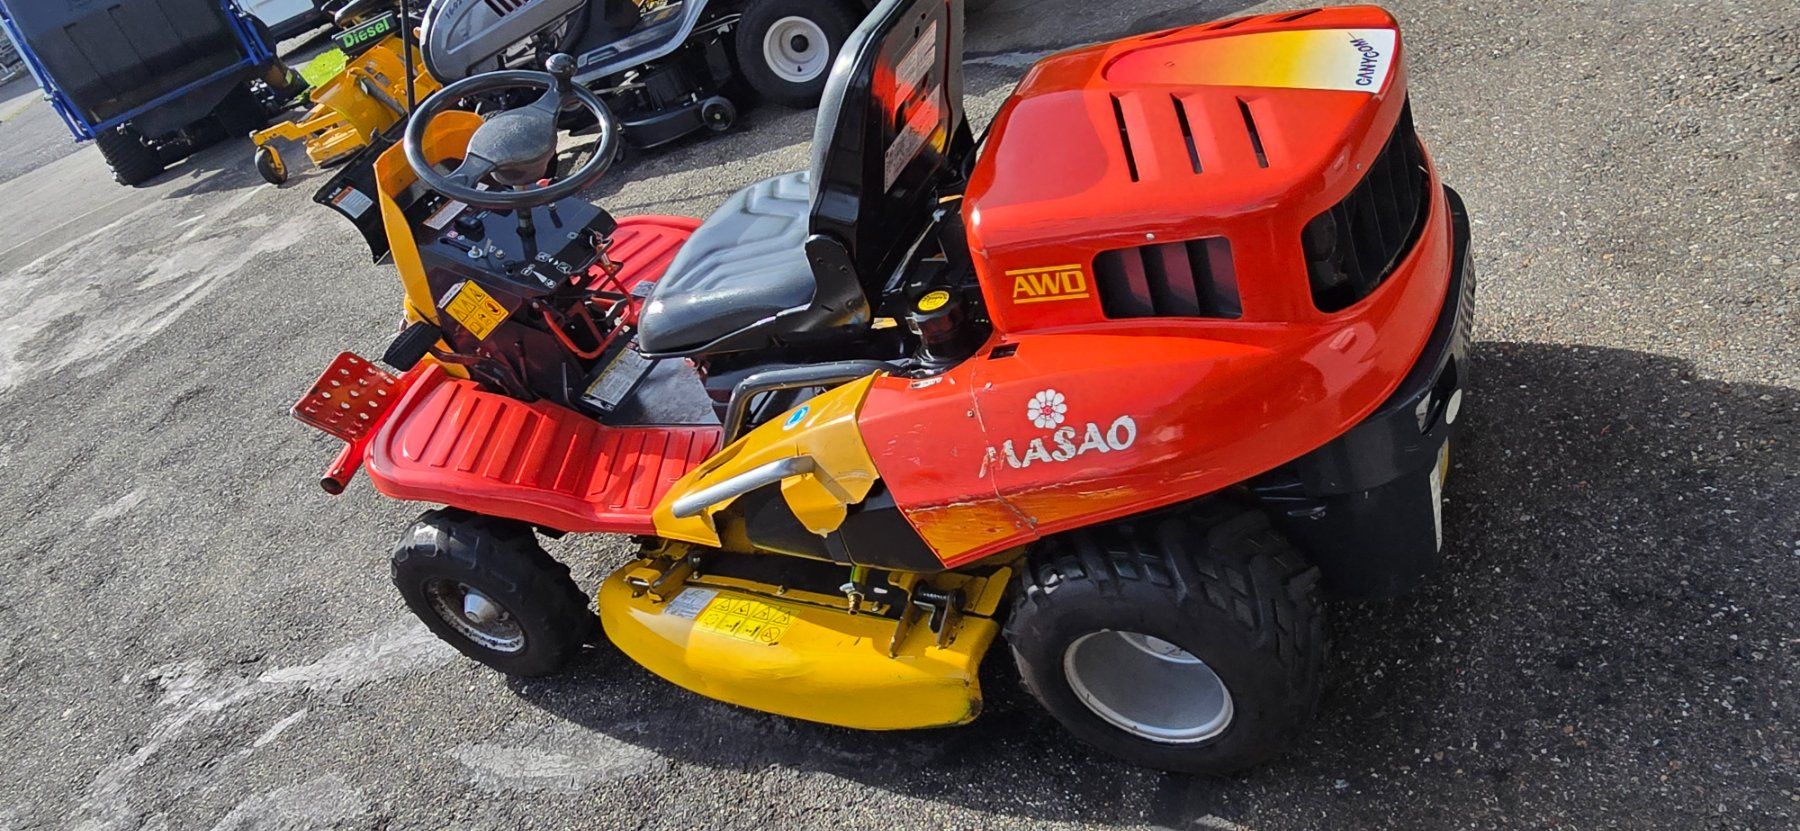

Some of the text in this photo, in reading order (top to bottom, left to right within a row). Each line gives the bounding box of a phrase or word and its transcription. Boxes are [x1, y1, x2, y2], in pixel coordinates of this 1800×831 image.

[342, 17, 390, 48] Diesel
[1350, 38, 1380, 86] CANYCOM
[1012, 270, 1087, 298] AWD
[979, 415, 1137, 479] MASAO
